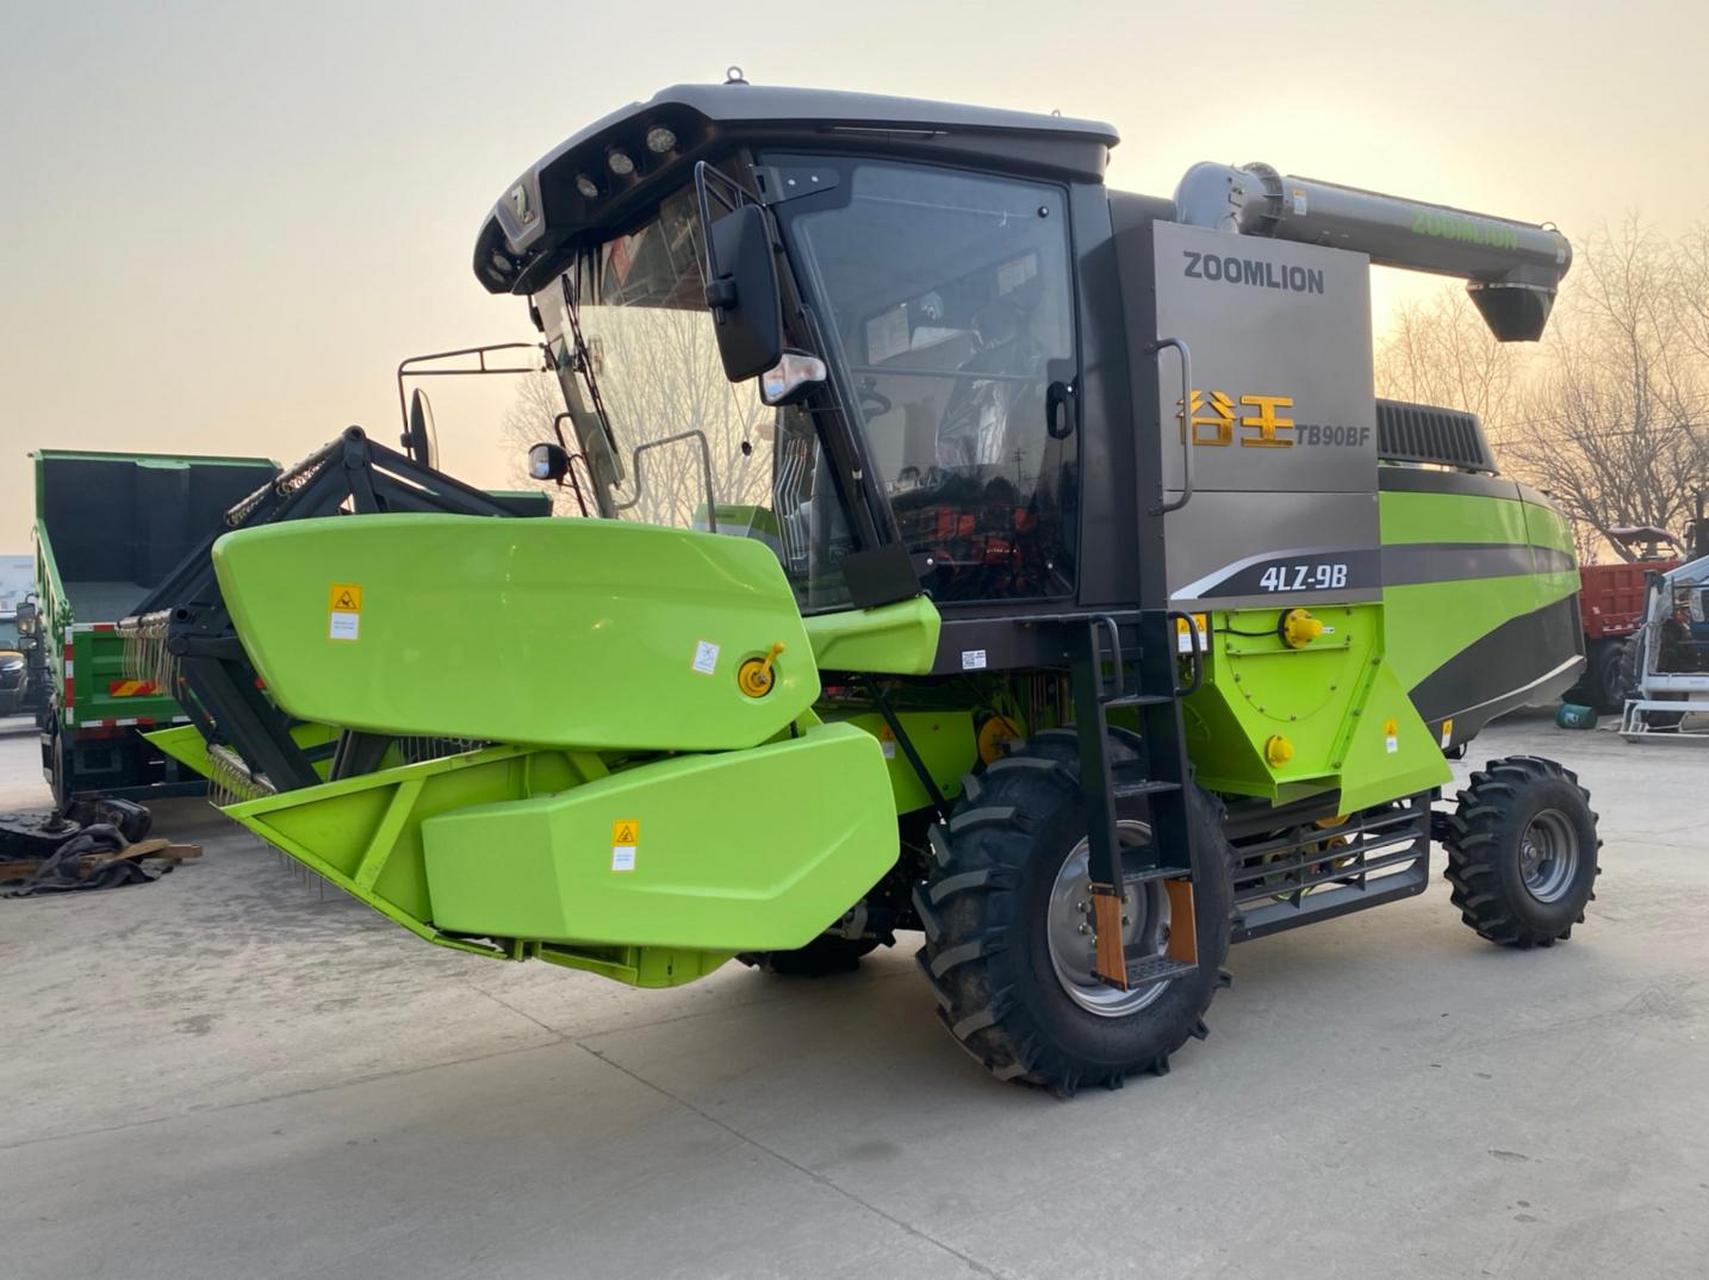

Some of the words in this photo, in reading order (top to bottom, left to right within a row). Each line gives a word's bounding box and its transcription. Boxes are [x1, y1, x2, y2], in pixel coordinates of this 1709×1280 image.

[1183, 251, 1325, 295] ZOOMLION
[1176, 389, 1294, 448] 谷王
[1295, 424, 1370, 446] TB90BF
[1259, 564, 1348, 592] 4LZ-9B
